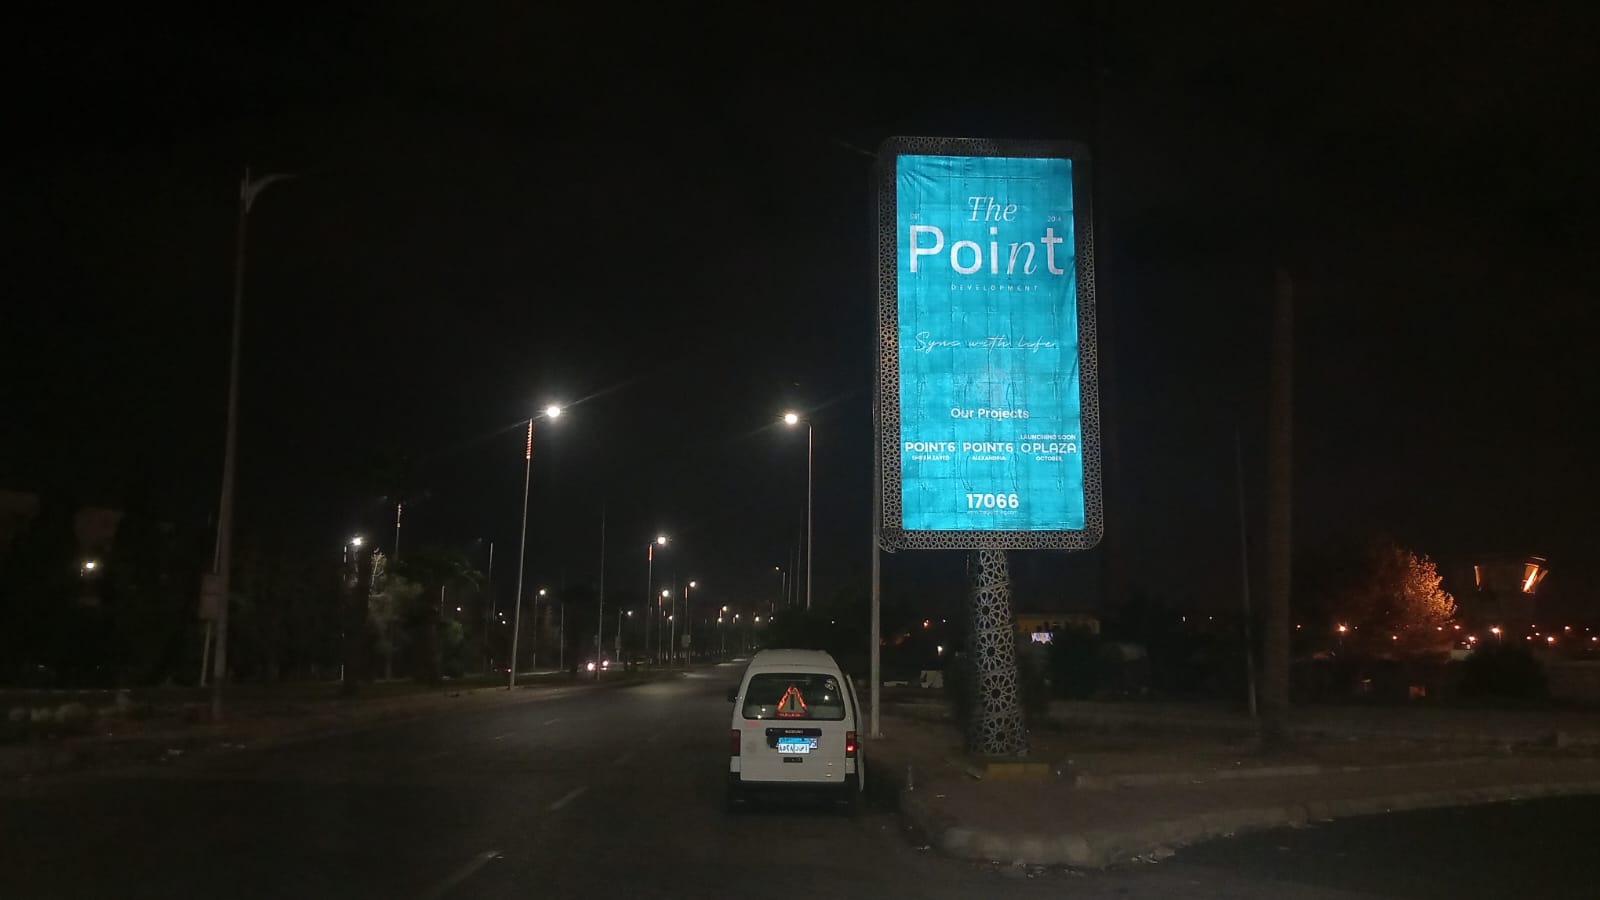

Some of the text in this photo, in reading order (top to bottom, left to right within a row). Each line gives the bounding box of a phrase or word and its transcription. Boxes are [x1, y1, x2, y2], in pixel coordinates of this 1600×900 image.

[967, 196, 1018, 222] The
[909, 224, 1064, 275] Point
[951, 283, 1038, 291] DEVELOPMENT
[913, 331, 961, 354] Sync
[968, 334, 1011, 353] with
[951, 407, 1030, 421] Our Projects
[1033, 443, 1077, 453] PLAZA
[966, 493, 1019, 509] 17066
